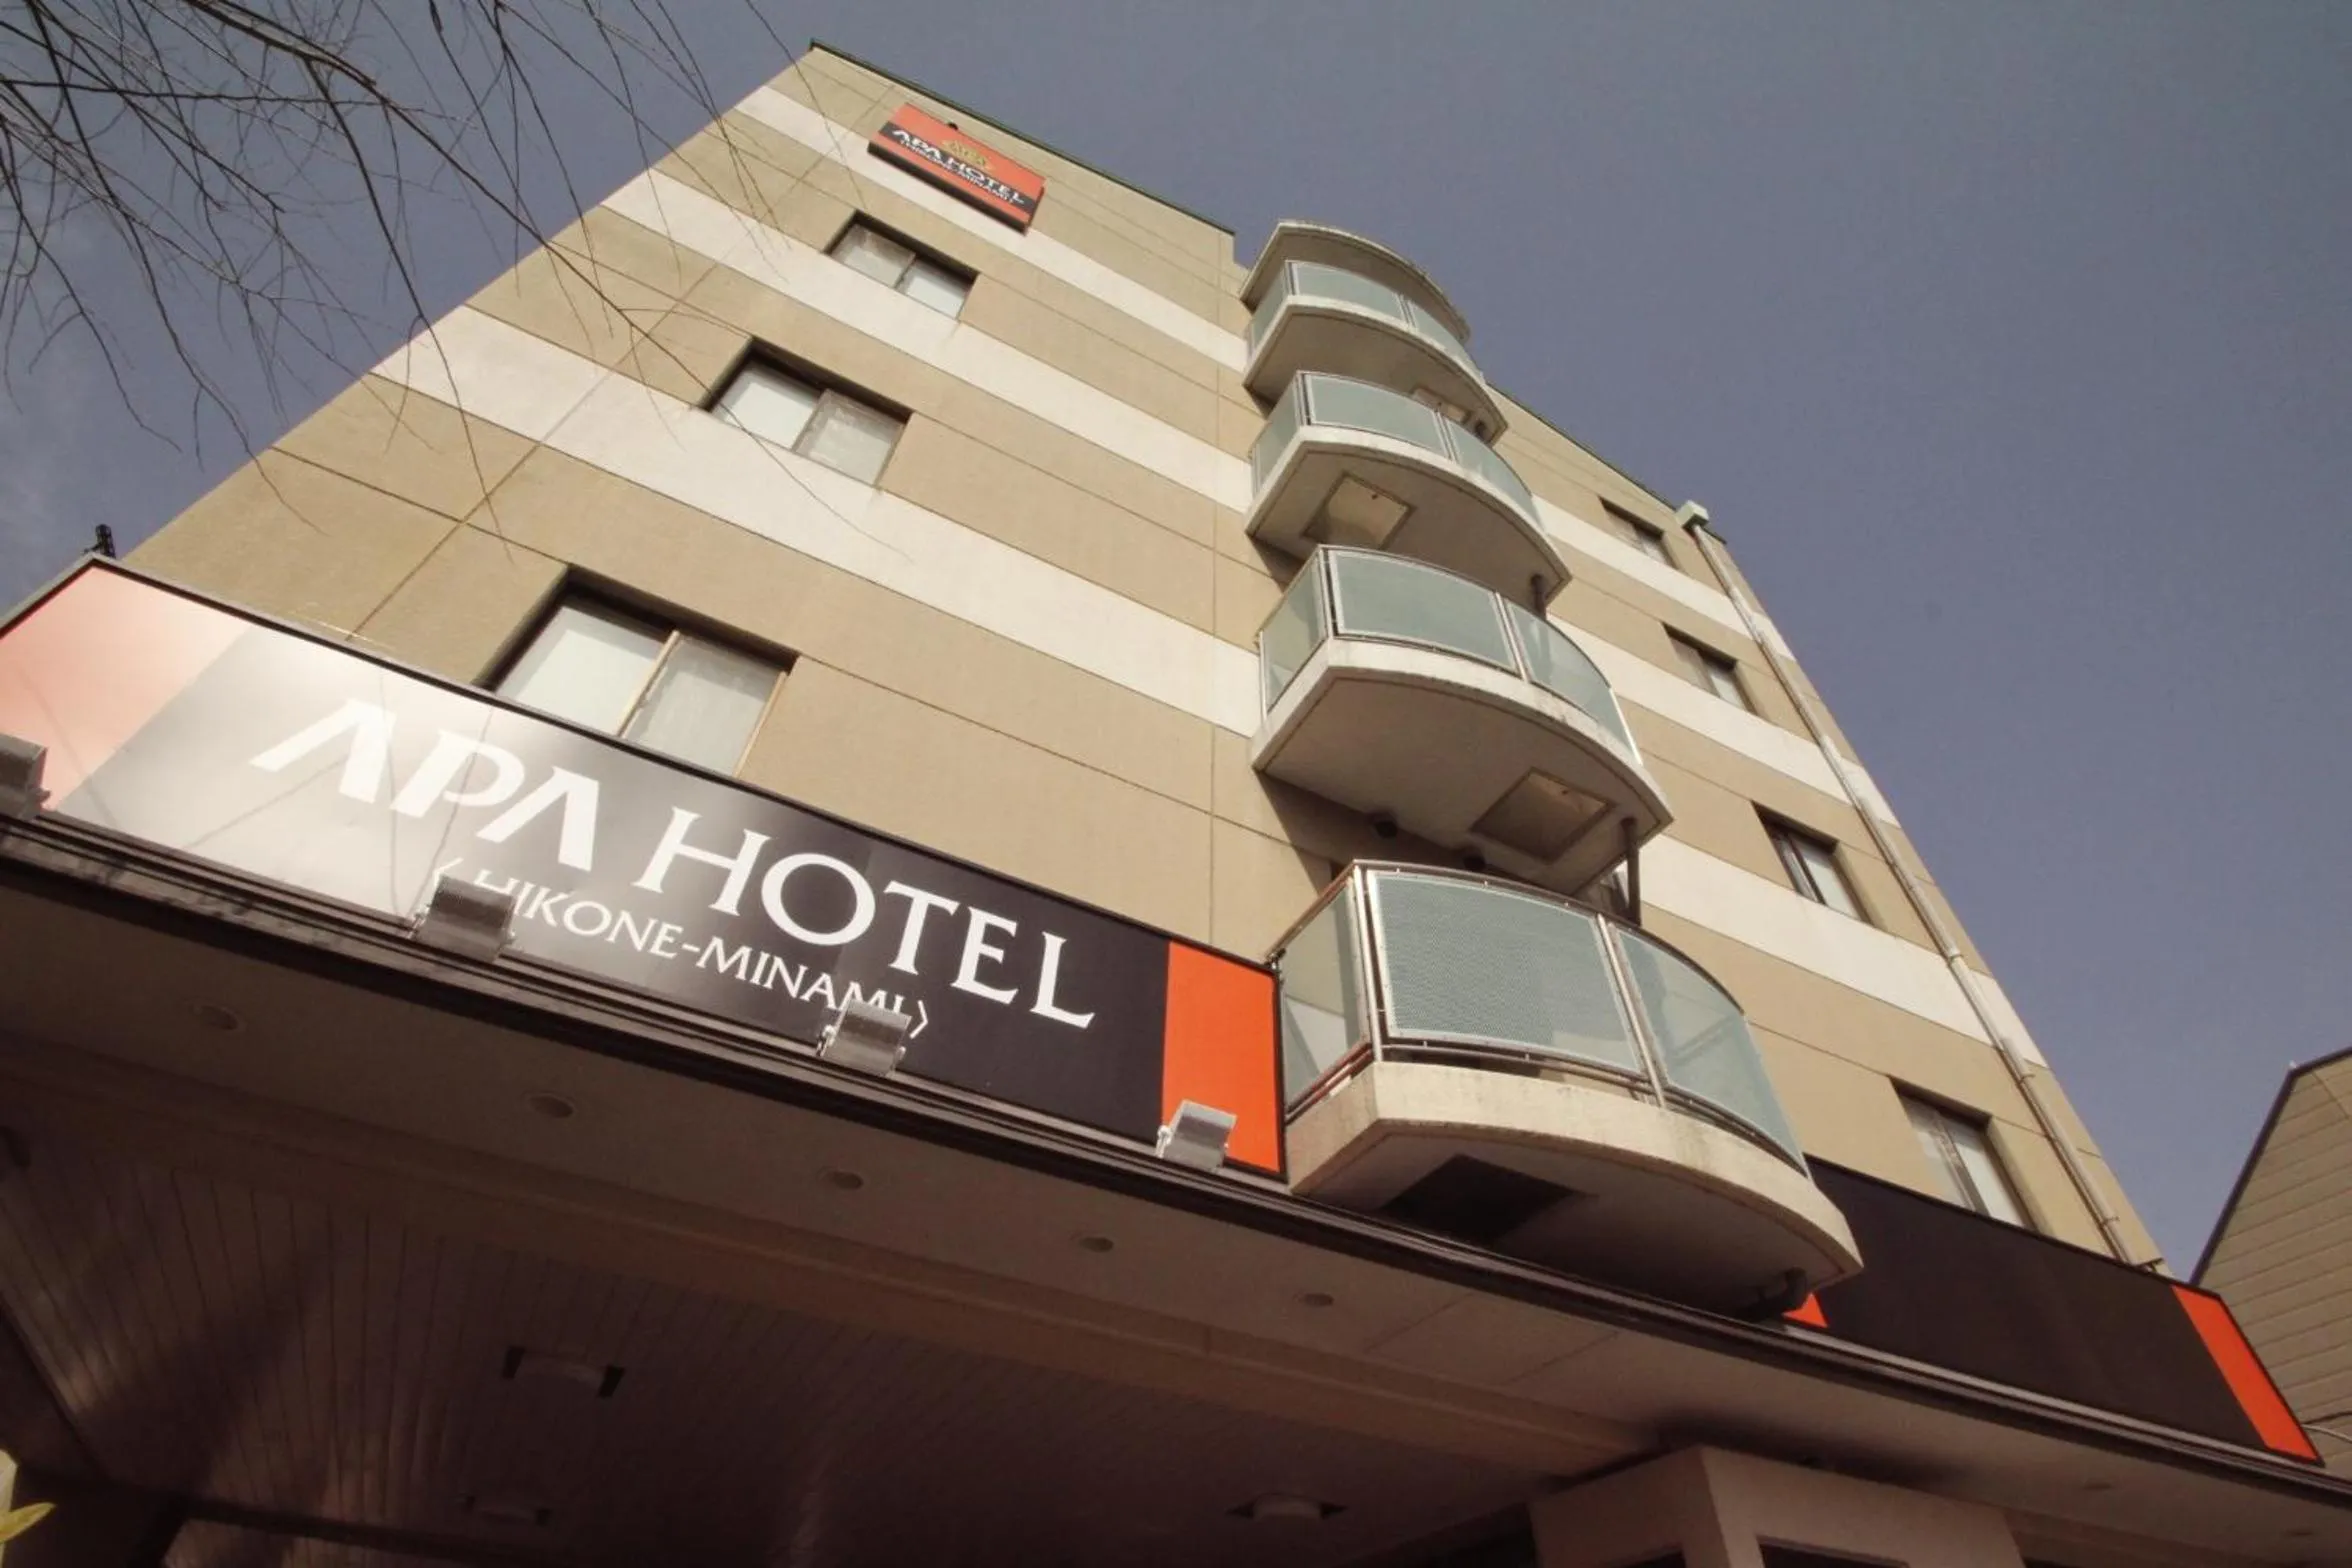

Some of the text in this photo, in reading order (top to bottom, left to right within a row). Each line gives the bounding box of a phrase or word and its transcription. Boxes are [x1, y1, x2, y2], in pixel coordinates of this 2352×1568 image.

[892, 129, 1025, 204] APA HOTEL
[249, 699, 1096, 1029] APA HOTEL
